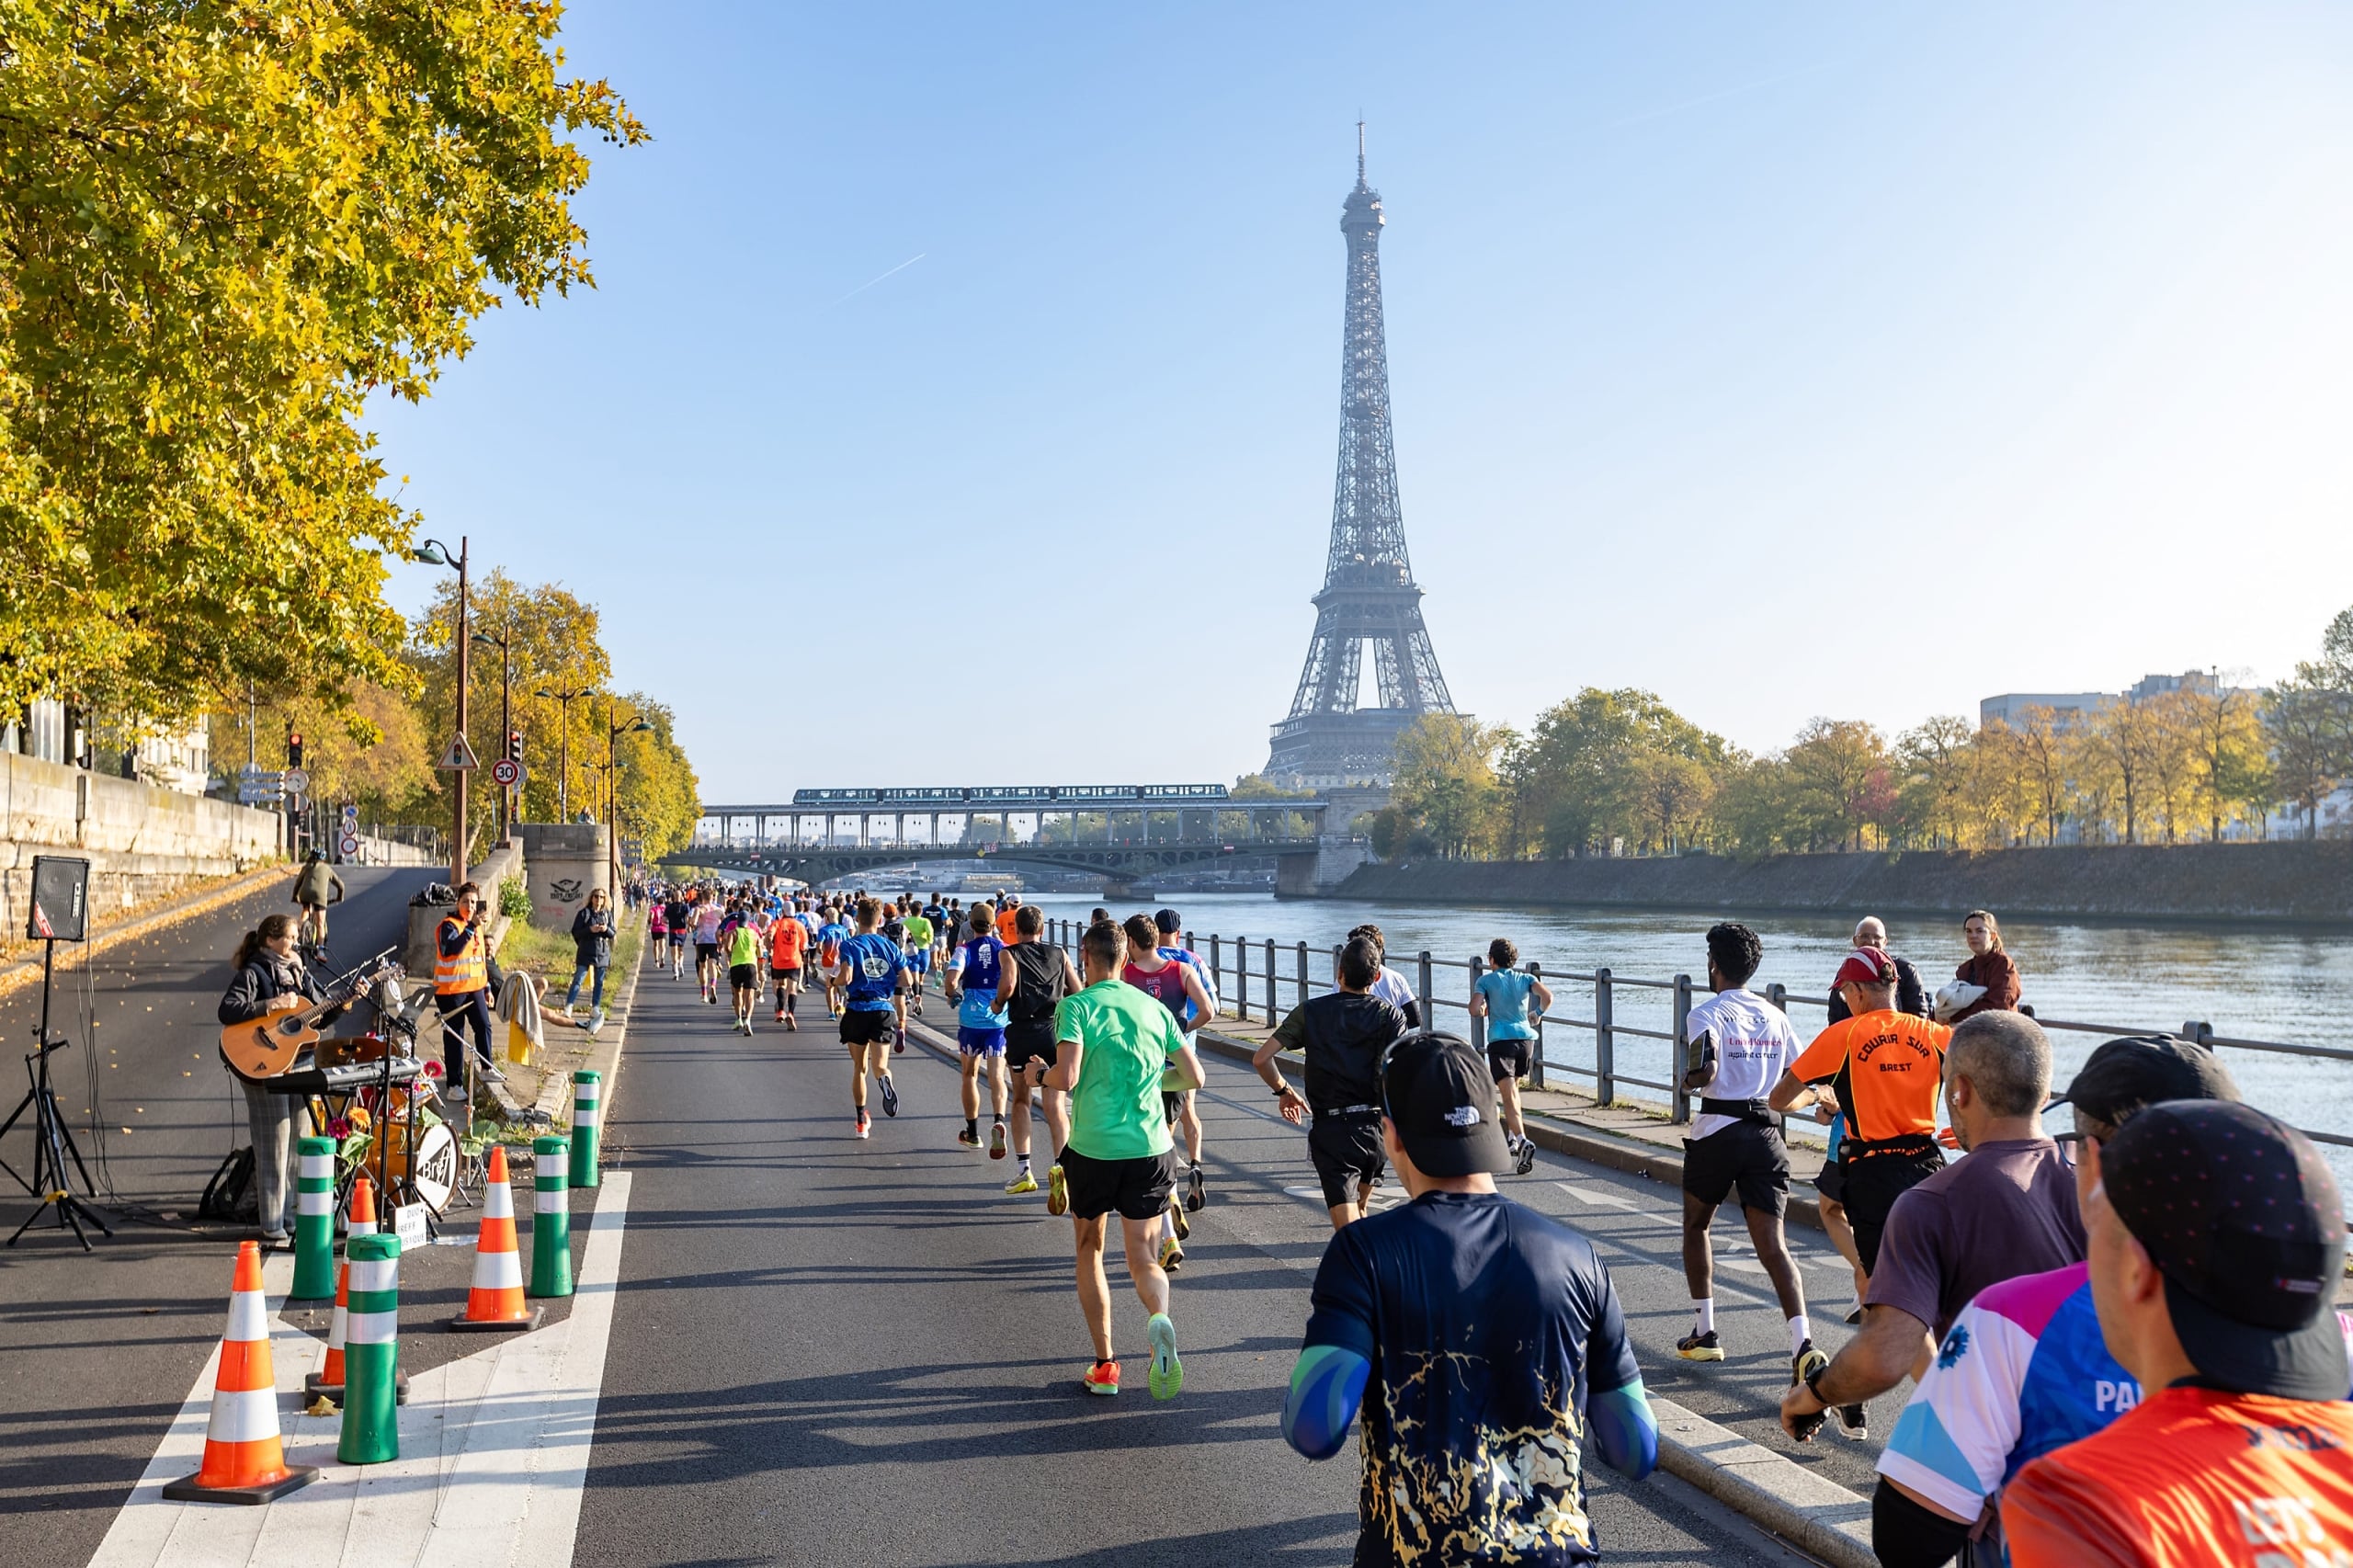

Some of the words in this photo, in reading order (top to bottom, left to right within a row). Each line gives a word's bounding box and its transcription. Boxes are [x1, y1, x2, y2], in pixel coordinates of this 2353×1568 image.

[497, 767, 514, 778] 30
[1857, 1033, 1899, 1062] COURIR
[1905, 1035, 1930, 1059] SUR
[1879, 1062, 1912, 1072] BREST
[406, 1208, 420, 1219] DUO
[401, 1233, 426, 1247] USIQUE
[2096, 1380, 2144, 1413] PA
